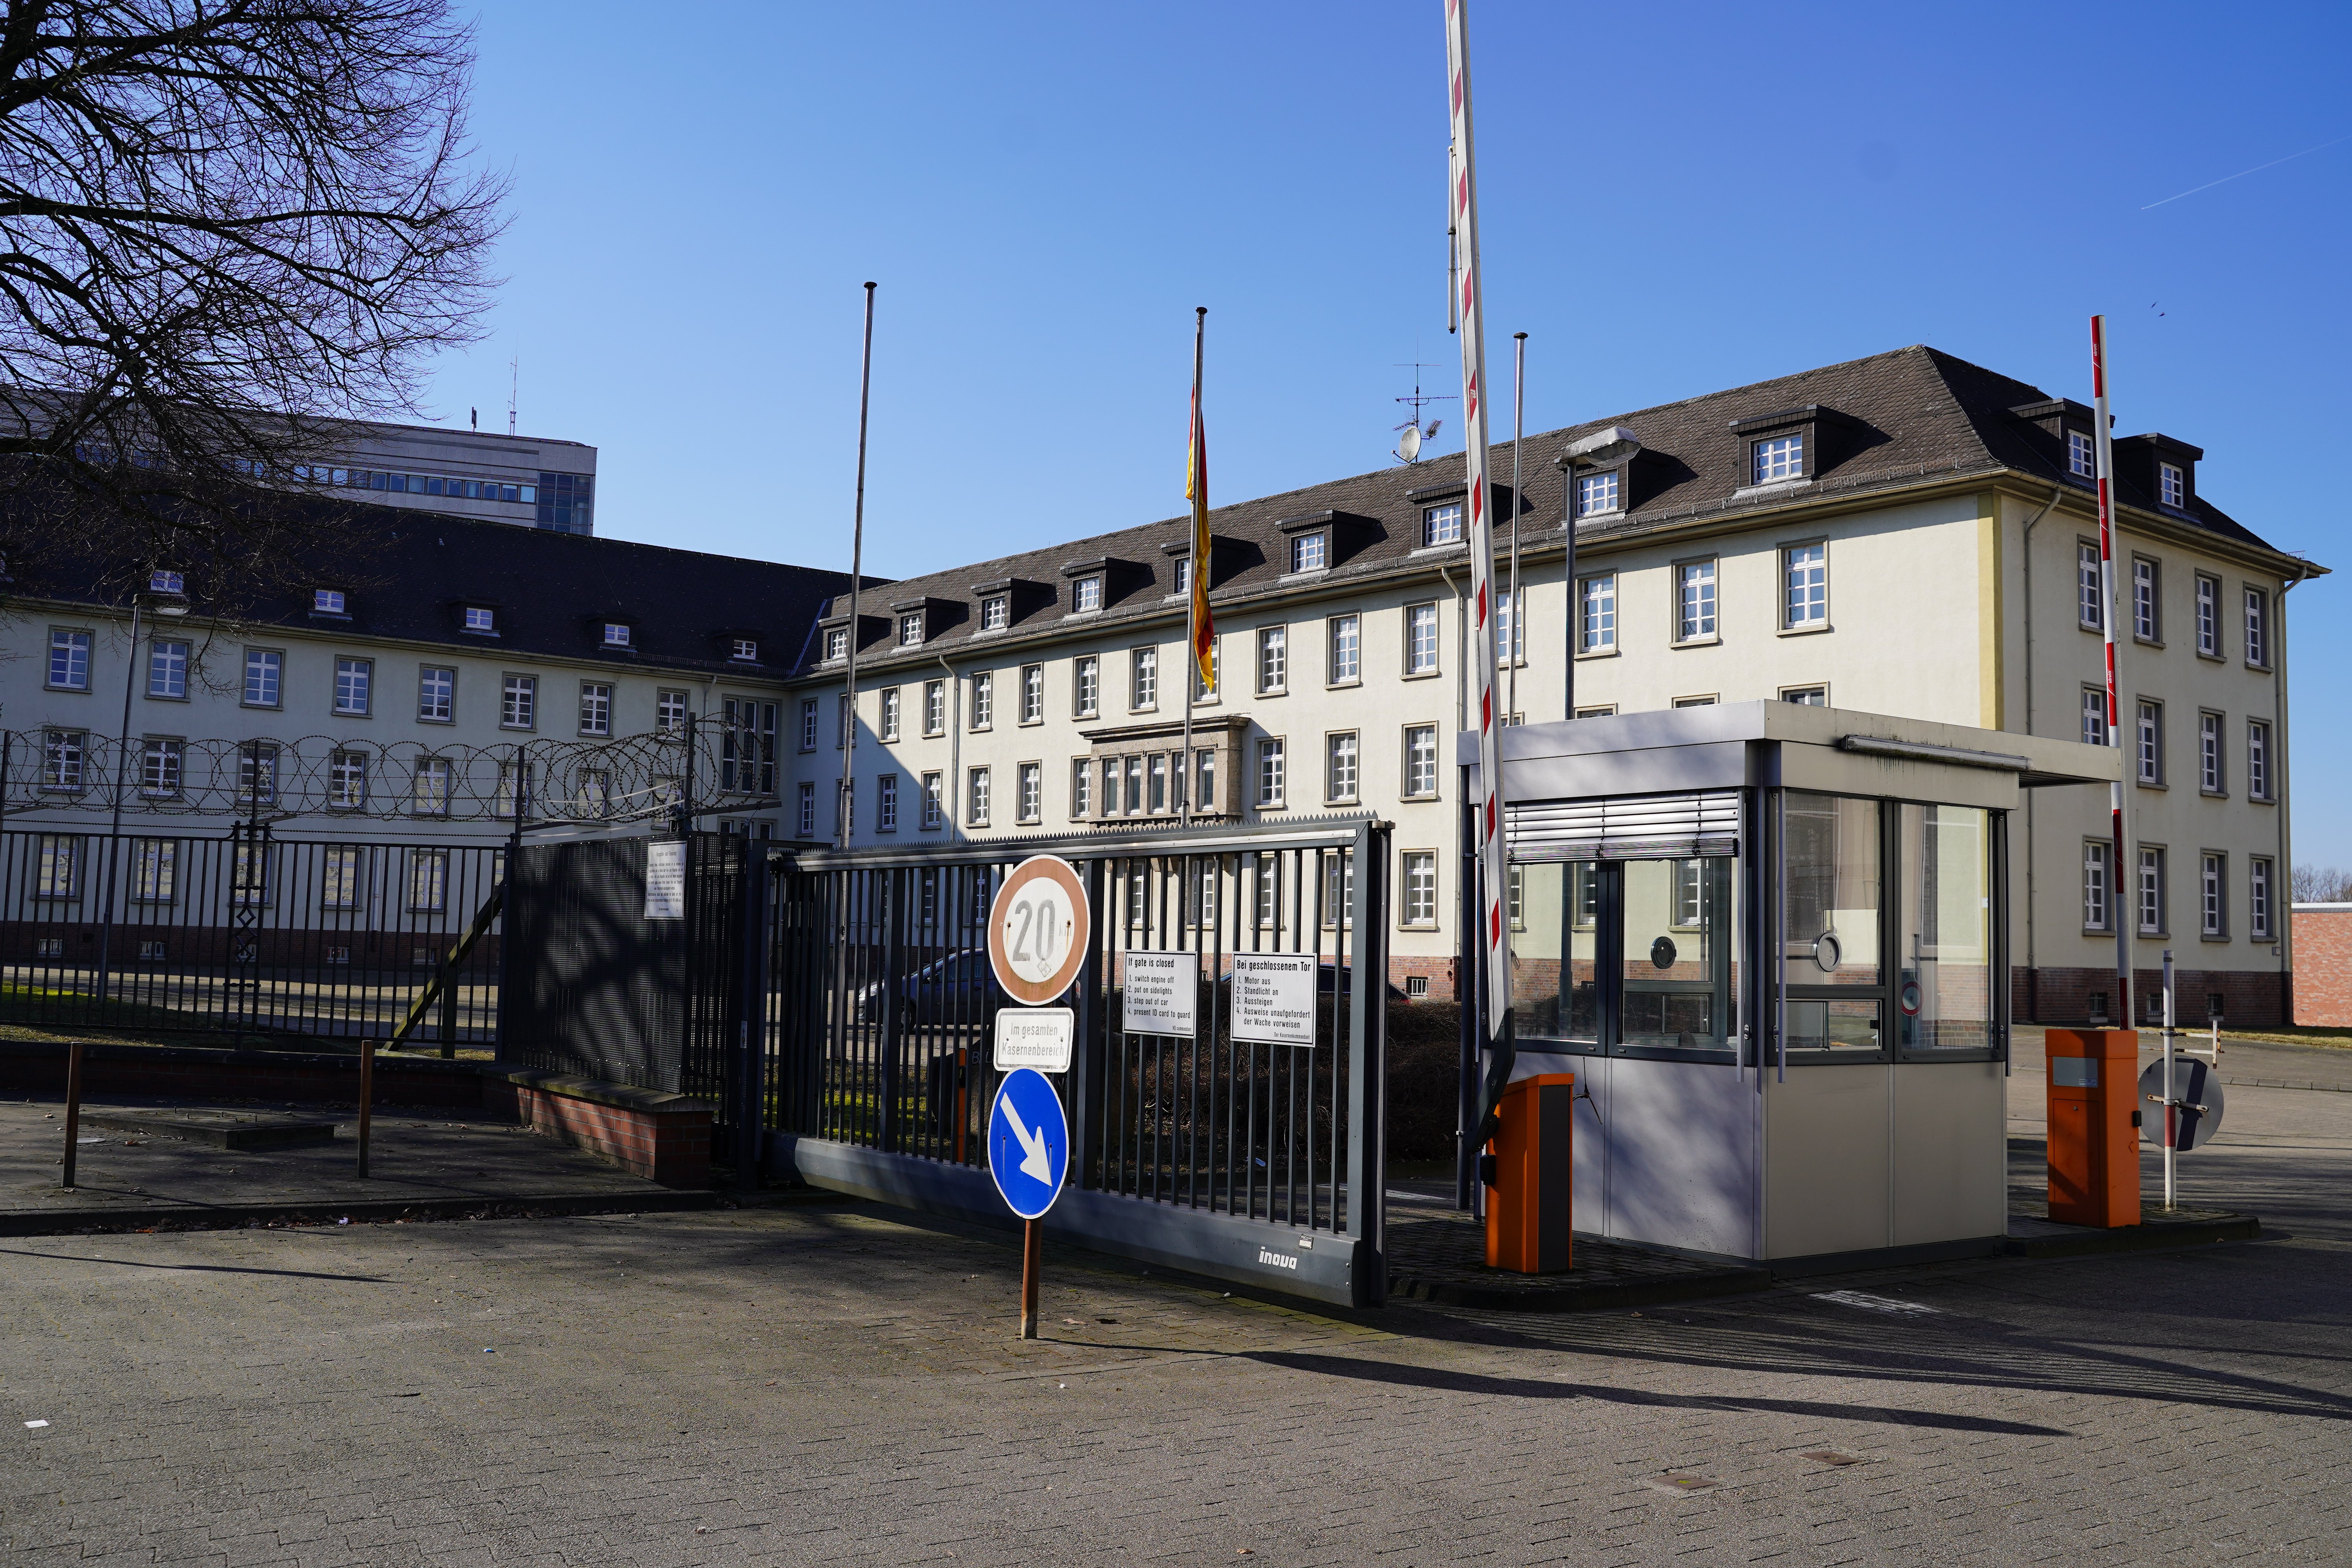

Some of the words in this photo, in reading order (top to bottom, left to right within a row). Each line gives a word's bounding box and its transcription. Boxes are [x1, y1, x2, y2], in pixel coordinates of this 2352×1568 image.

[1013, 899, 1055, 961] 20
[1129, 958, 1132, 966] If
[1135, 958, 1147, 968] gate
[1149, 958, 1154, 967] is
[1156, 958, 1174, 967] closed
[1237, 960, 1246, 969] Bei
[1249, 960, 1298, 971] geschlossenem
[1300, 962, 1311, 971] Tor
[1150, 987, 1172, 995] sidelights
[1245, 986, 1270, 995] Standlicht
[1244, 997, 1272, 1007] Aussteigen
[1244, 1007, 1268, 1016] Ausweise
[1271, 1009, 1310, 1018] unaufgefordert
[1254, 1018, 1270, 1026] Wache
[1273, 1020, 1300, 1029] vorweisen
[1011, 1022, 1019, 1035] Im
[1022, 1024, 1058, 1039] gesamten
[1002, 1042, 1063, 1056] Kasernenbereich
[1259, 1246, 1297, 1270] inova
